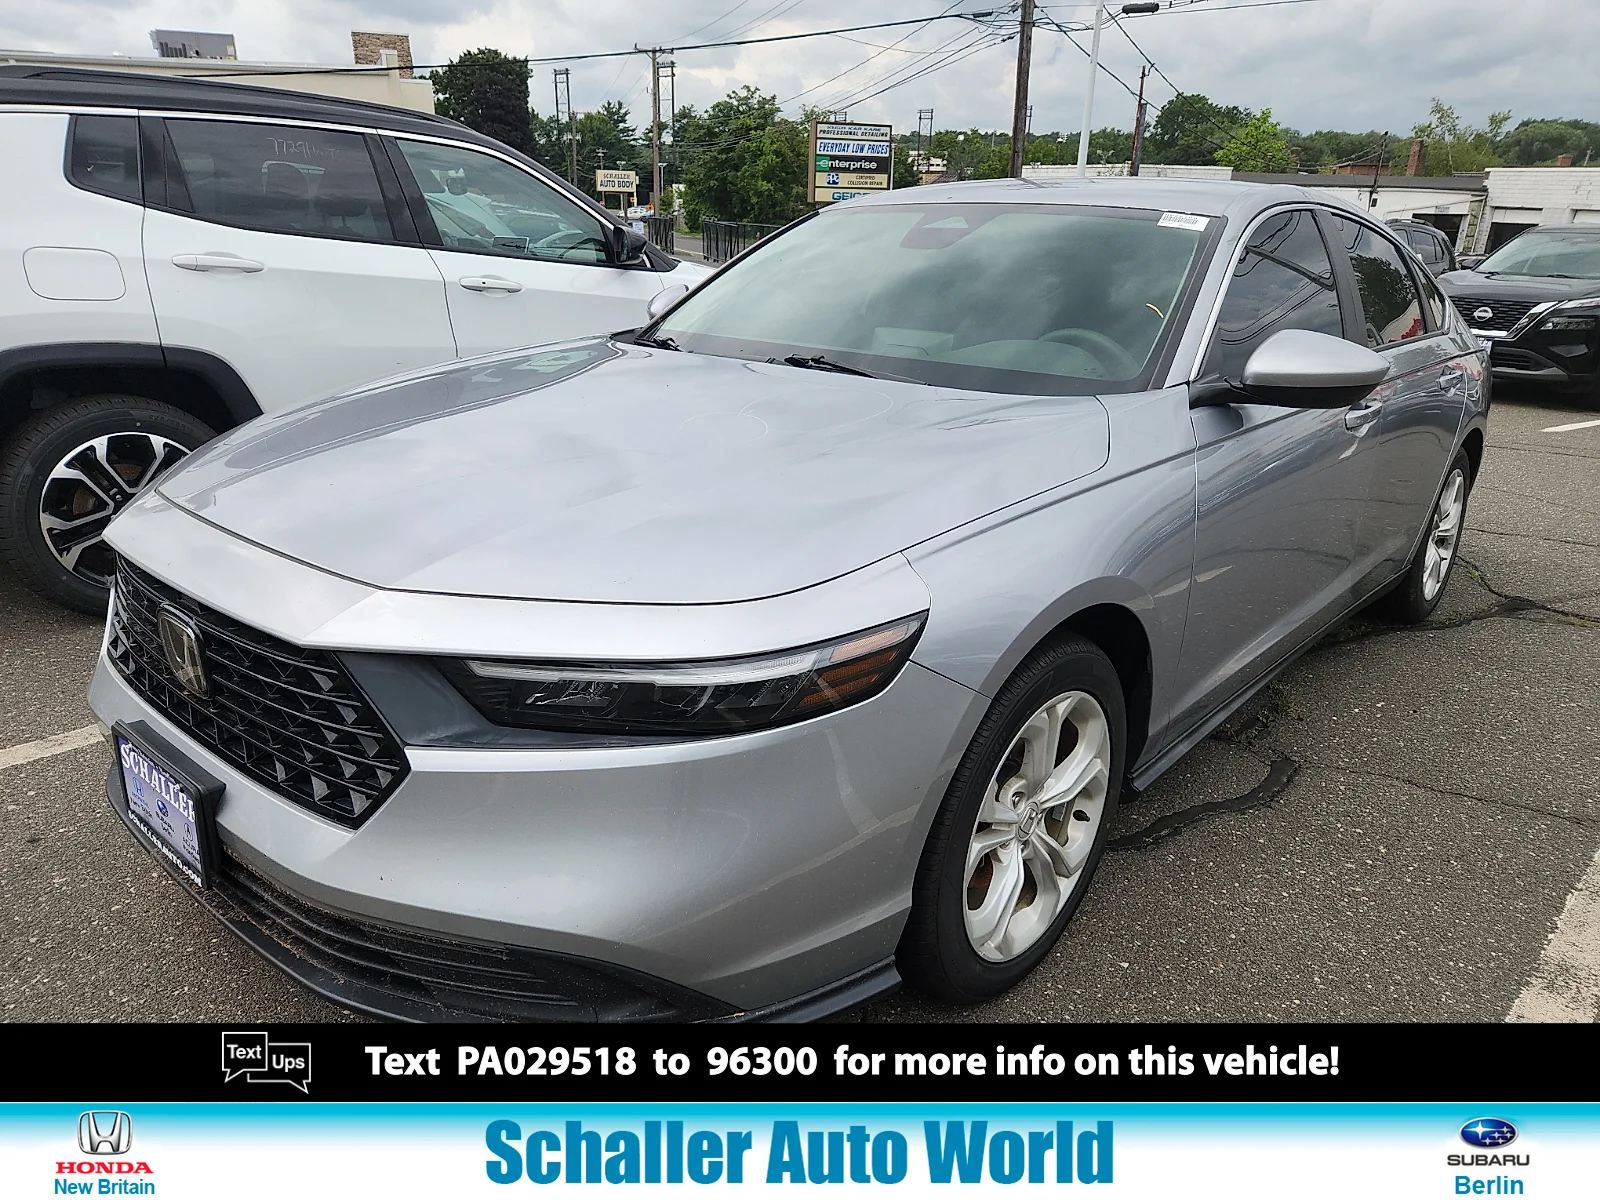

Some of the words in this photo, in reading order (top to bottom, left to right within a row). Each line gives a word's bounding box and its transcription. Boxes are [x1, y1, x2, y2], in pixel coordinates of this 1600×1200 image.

[819, 129, 859, 137] PROFESSIONAL
[819, 142, 850, 153] EVERYDAY
[852, 143, 865, 154] LOW
[867, 144, 889, 154] PRICES
[816, 160, 877, 170] enterprise
[600, 179, 616, 188] AUTO
[617, 180, 634, 189] BODY
